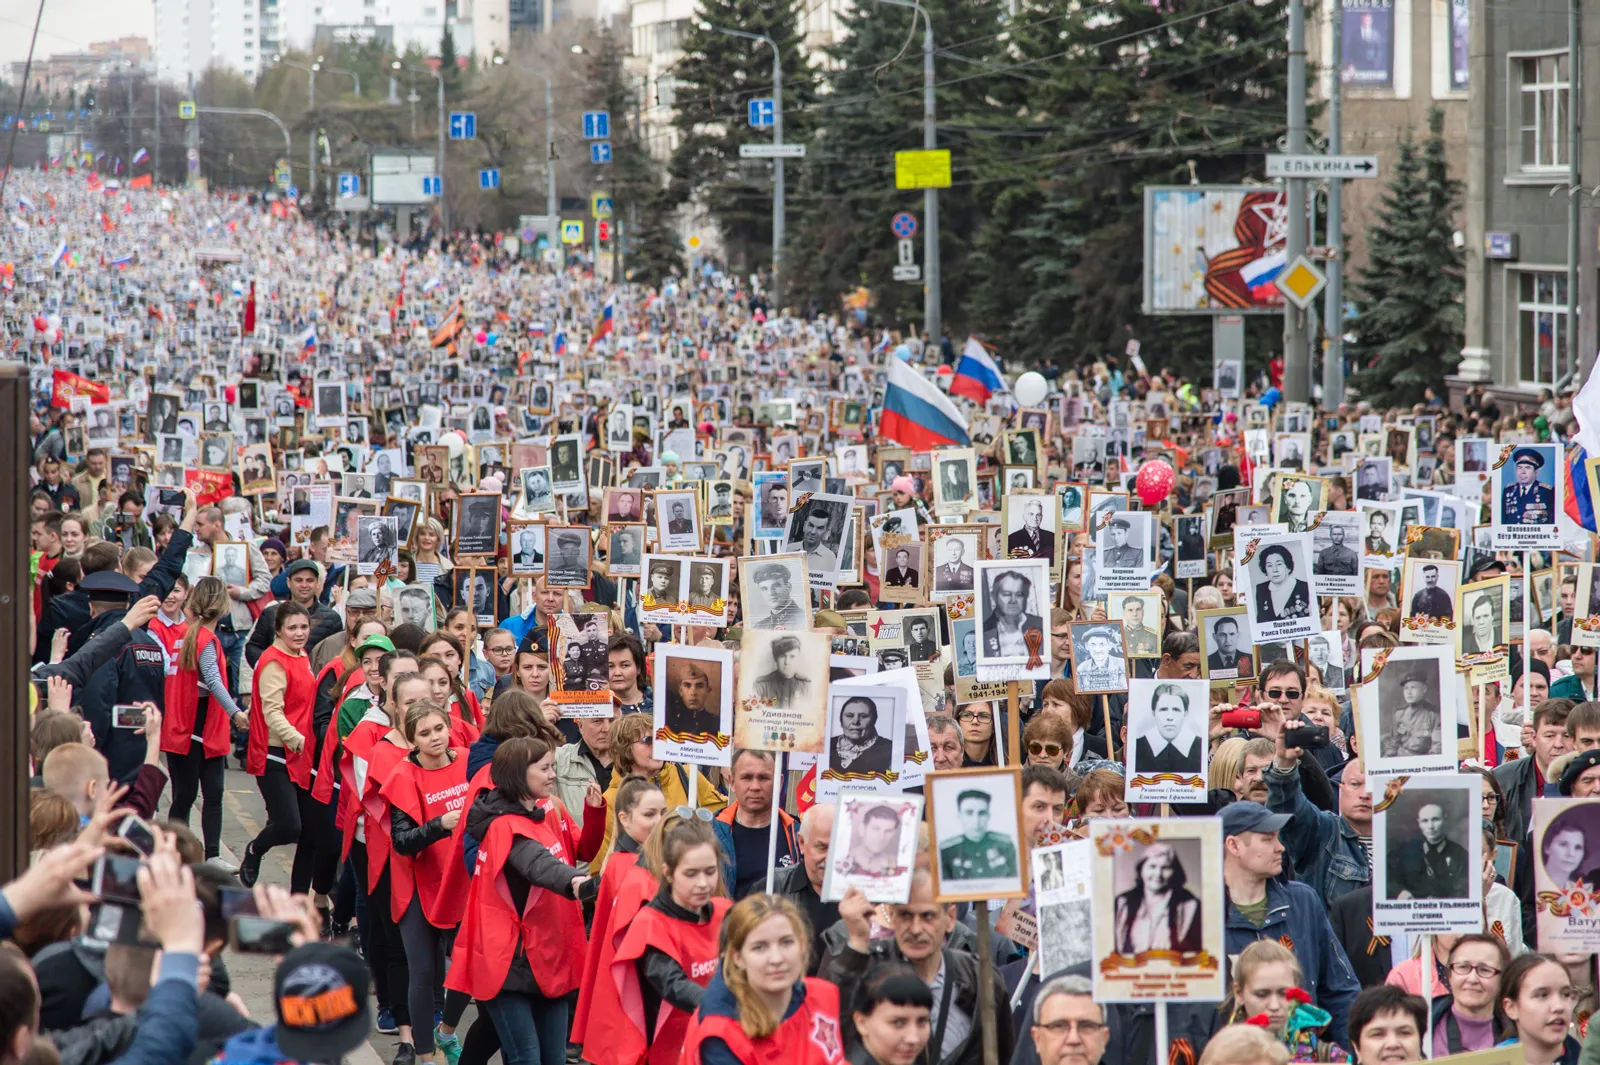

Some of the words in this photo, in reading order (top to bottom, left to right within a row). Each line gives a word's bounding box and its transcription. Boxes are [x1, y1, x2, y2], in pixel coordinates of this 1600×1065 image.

[1284, 160, 1351, 172] ЕЛЬКИНА
[878, 628, 900, 639] ПОЛК
[1261, 629, 1279, 637] Раиса
[1279, 626, 1311, 635] Гордеевна
[135, 650, 162, 662] ПОЛИЦИЯ
[762, 709, 802, 719] Удиванов
[748, 717, 782, 725] Александр
[783, 719, 814, 727] Иванович
[1375, 902, 1412, 910] Конышев
[1413, 901, 1437, 909] Семён
[1014, 924, 1032, 937] Зоя
